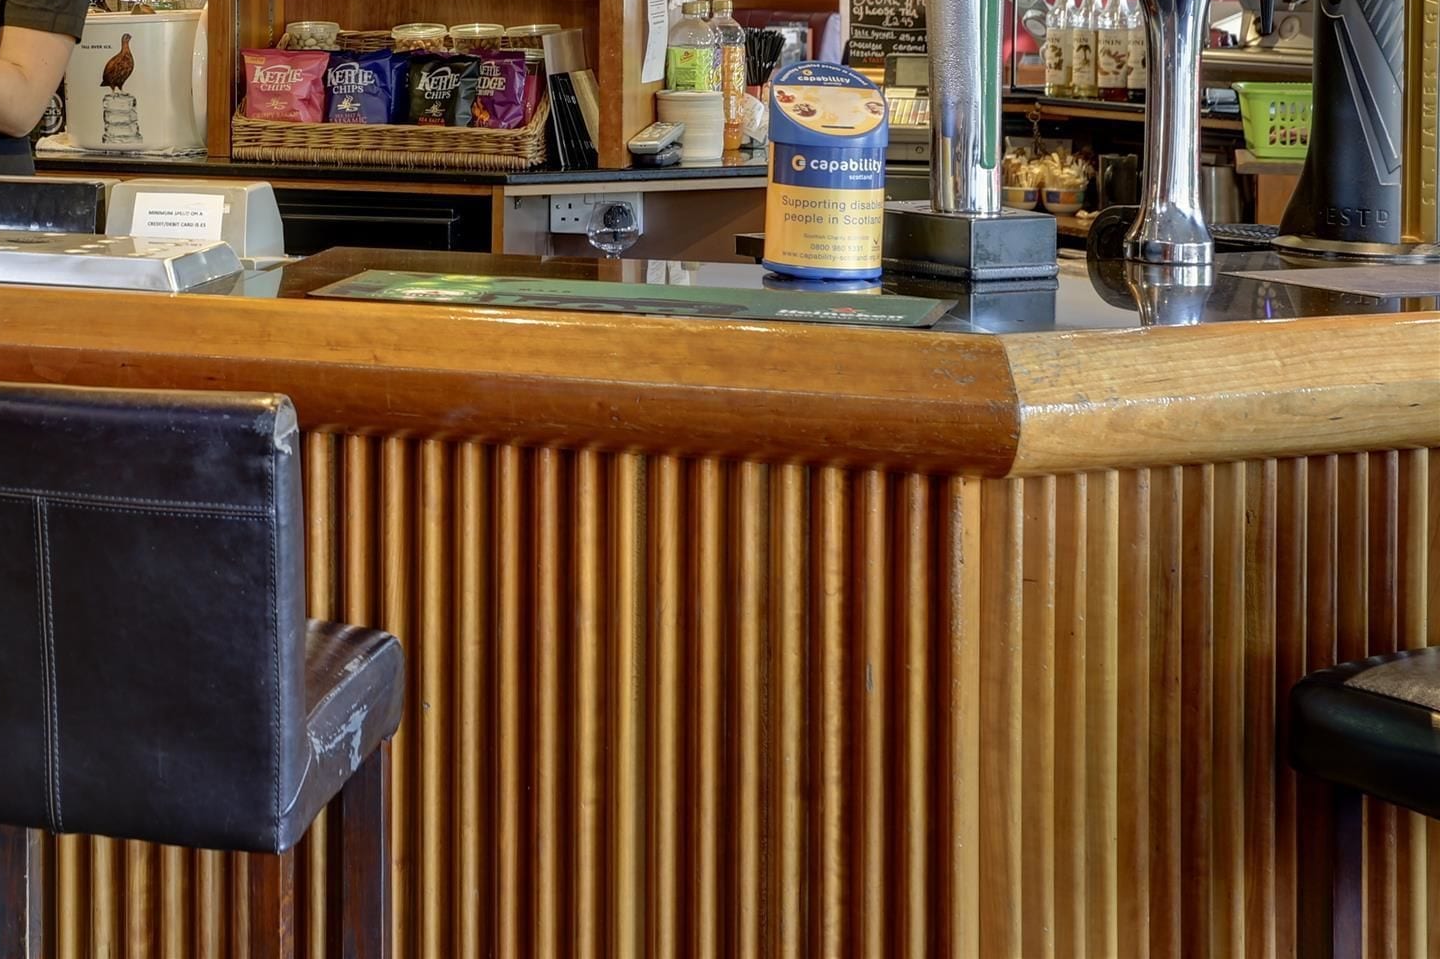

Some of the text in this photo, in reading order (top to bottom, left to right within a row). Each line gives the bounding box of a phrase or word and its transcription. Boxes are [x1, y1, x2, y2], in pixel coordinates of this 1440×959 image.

[252, 64, 304, 84] KETTLE
[326, 61, 376, 87] KETTLE
[416, 66, 462, 91] KETTLE
[797, 75, 851, 84] capability
[260, 83, 292, 91] CHIPS
[332, 85, 364, 95] CHIPS
[424, 90, 452, 100] CHIPS
[810, 158, 882, 174] capability
[781, 195, 847, 213] Supporting
[784, 212, 824, 225] people
[828, 214, 839, 225] in
[809, 243, 830, 251] 0800
